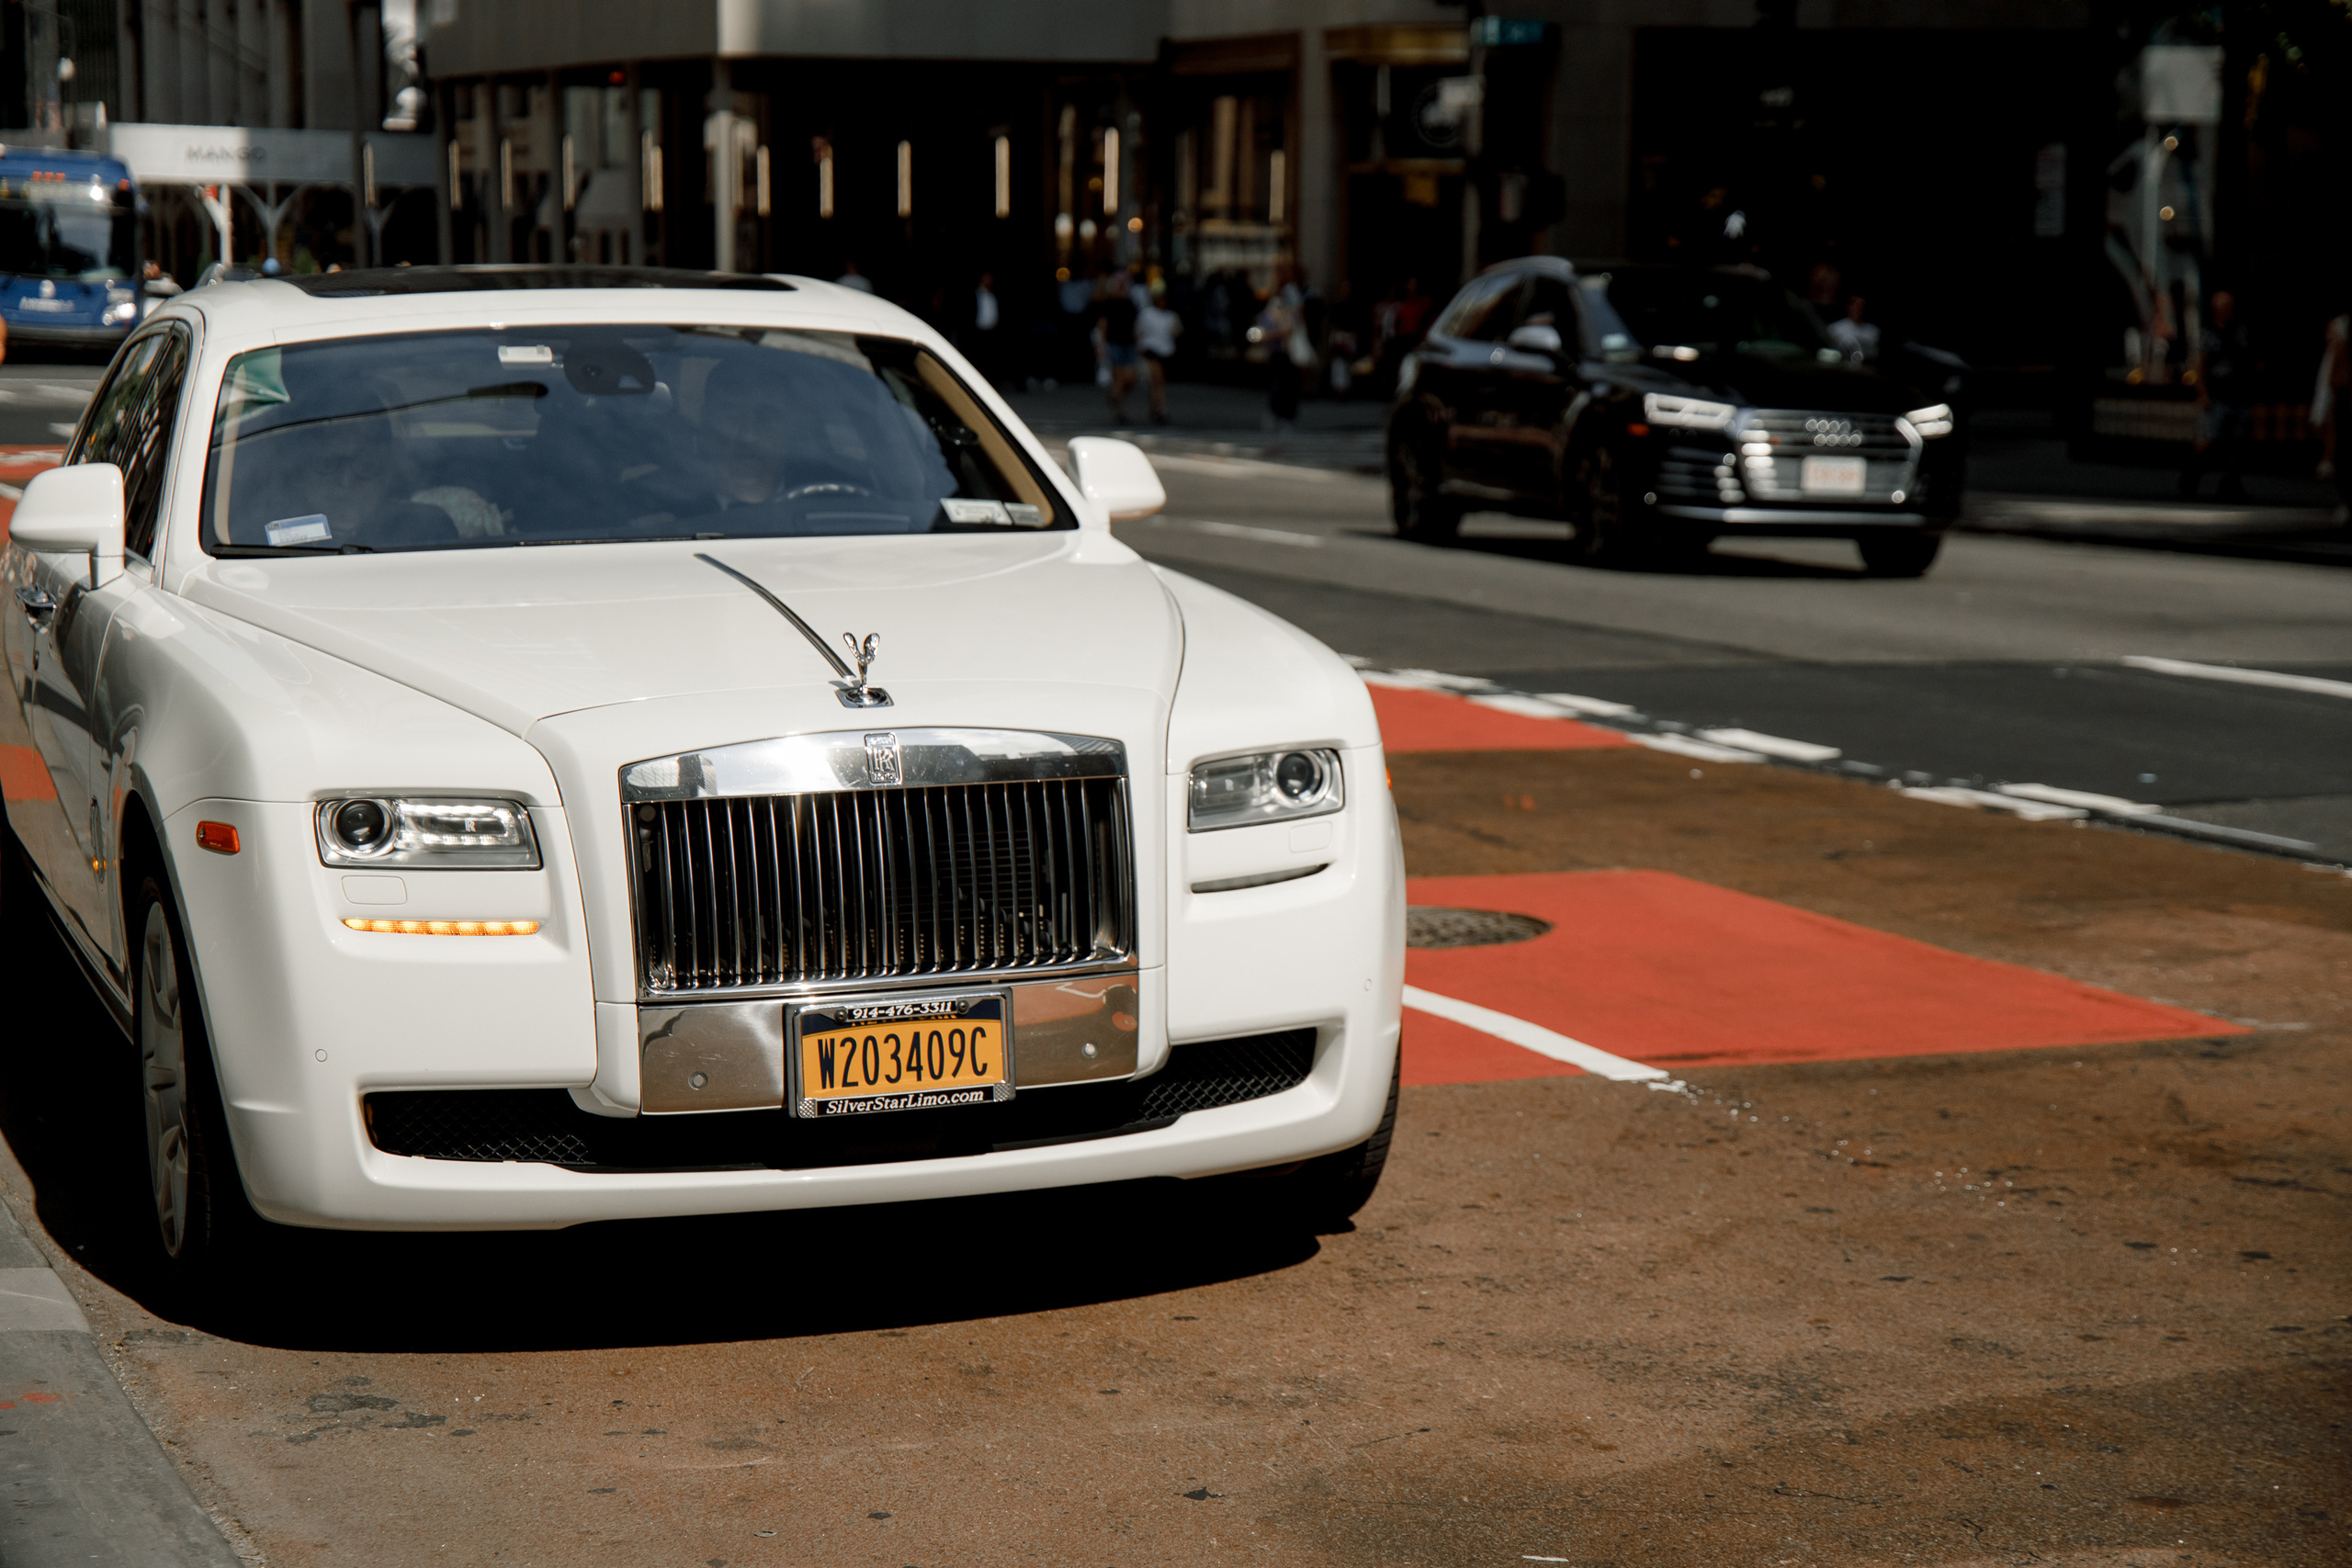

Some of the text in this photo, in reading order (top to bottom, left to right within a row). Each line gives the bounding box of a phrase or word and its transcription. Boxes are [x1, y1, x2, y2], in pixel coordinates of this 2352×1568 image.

[853, 1001, 952, 1019] 914-476-3311
[818, 1027, 988, 1089] W203409C
[826, 1090, 984, 1114] SilverStarLimo.com
